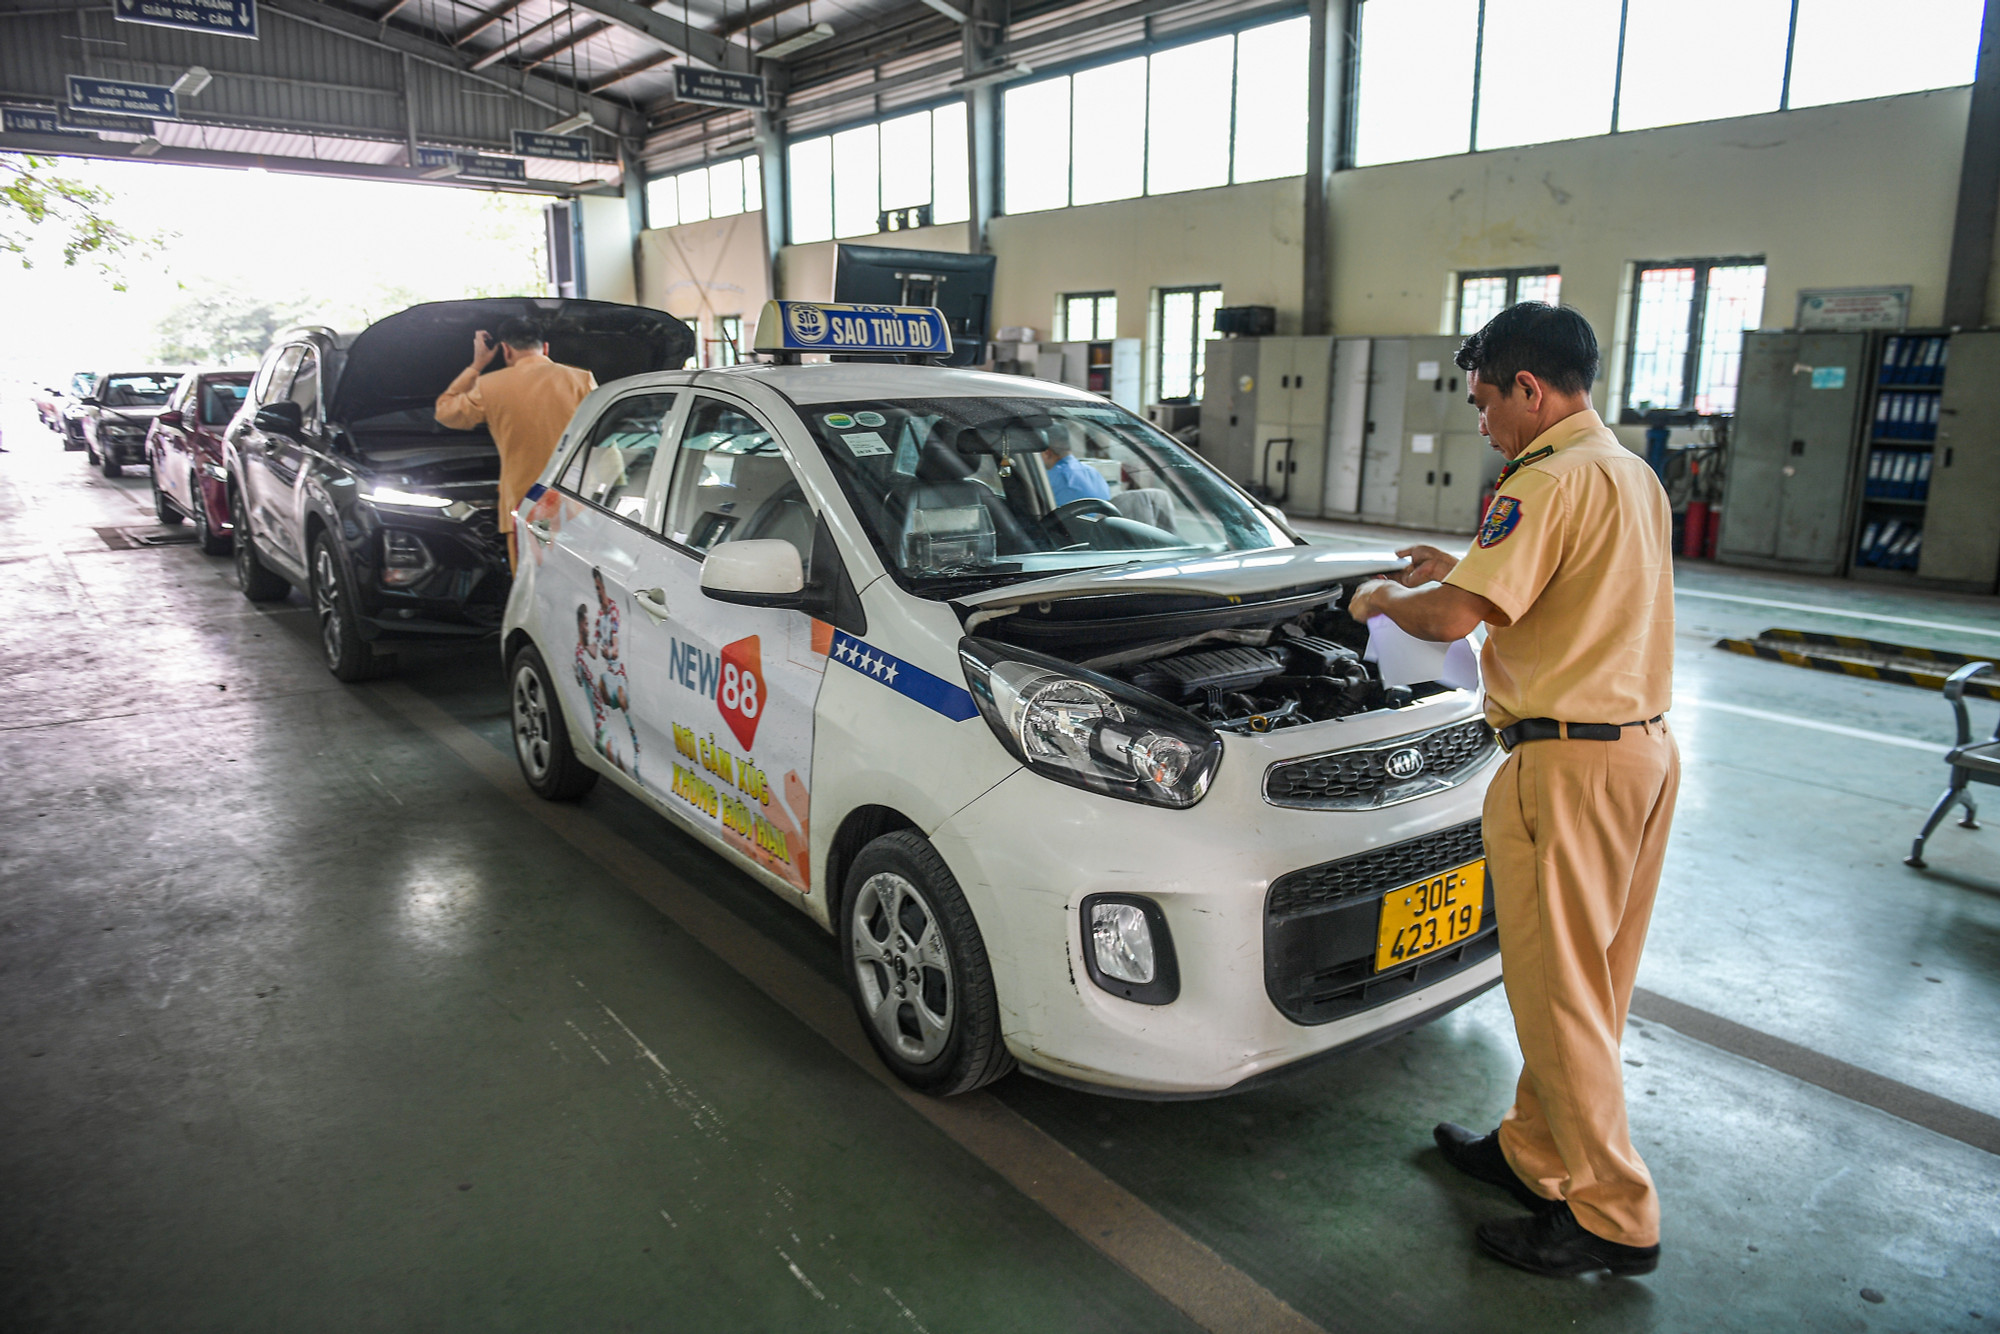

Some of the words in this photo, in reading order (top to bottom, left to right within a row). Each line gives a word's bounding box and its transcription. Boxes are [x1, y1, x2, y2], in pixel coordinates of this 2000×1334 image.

[853, 305, 896, 313] TAXI
[831, 316, 869, 346] SAO
[870, 311, 906, 347] THỦ
[907, 316, 933, 348] ĐÔ
[1392, 754, 1421, 774] KIA
[1413, 872, 1459, 918] 30E
[1390, 903, 1473, 960] 423.19
